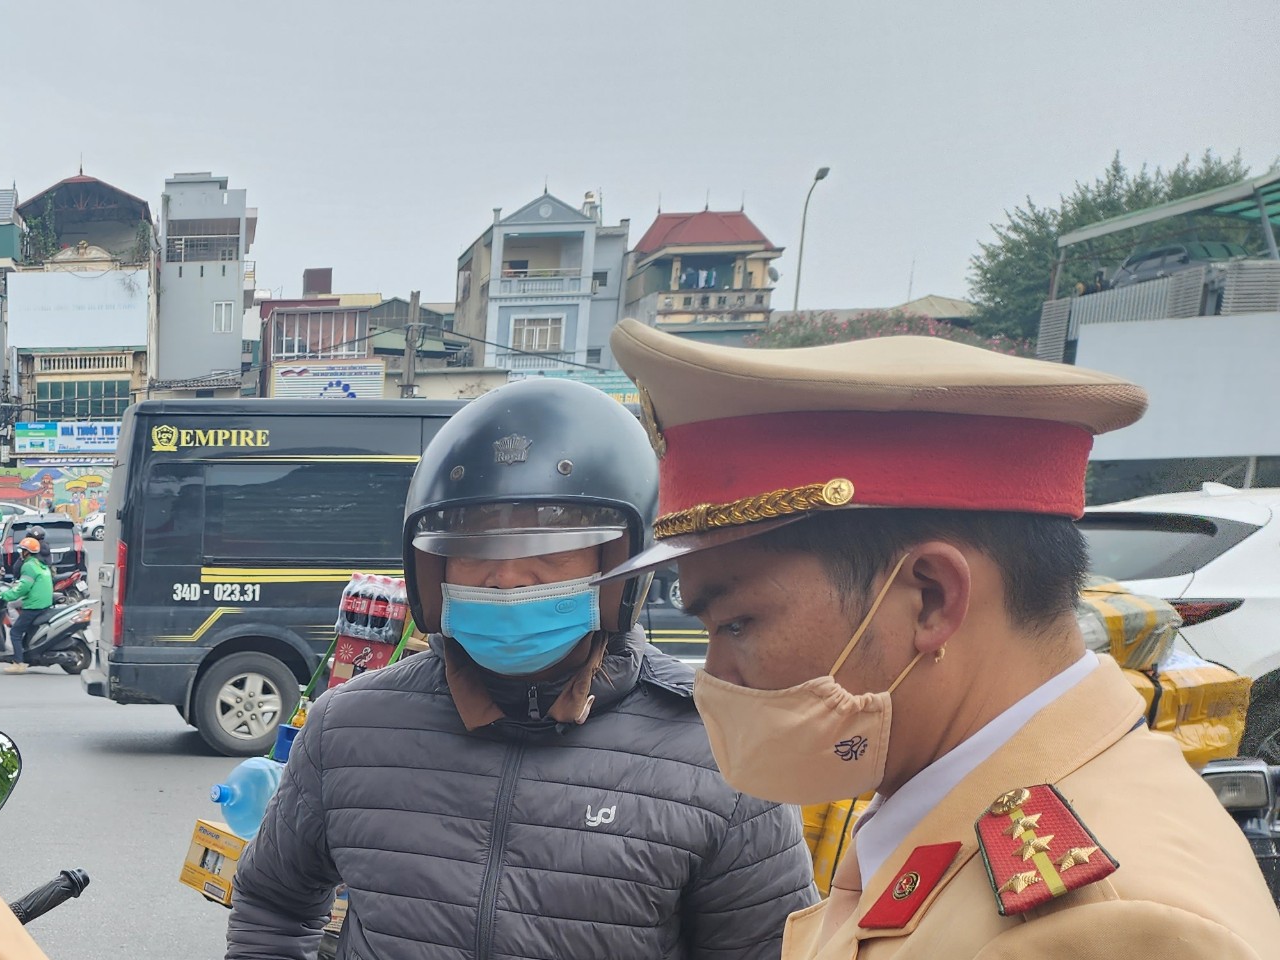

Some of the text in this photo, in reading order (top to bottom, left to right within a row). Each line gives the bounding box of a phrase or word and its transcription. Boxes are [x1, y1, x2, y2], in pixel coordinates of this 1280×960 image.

[179, 429, 270, 447] EMPIRE
[173, 583, 201, 601] 34D
[213, 583, 261, 602] 023.31
